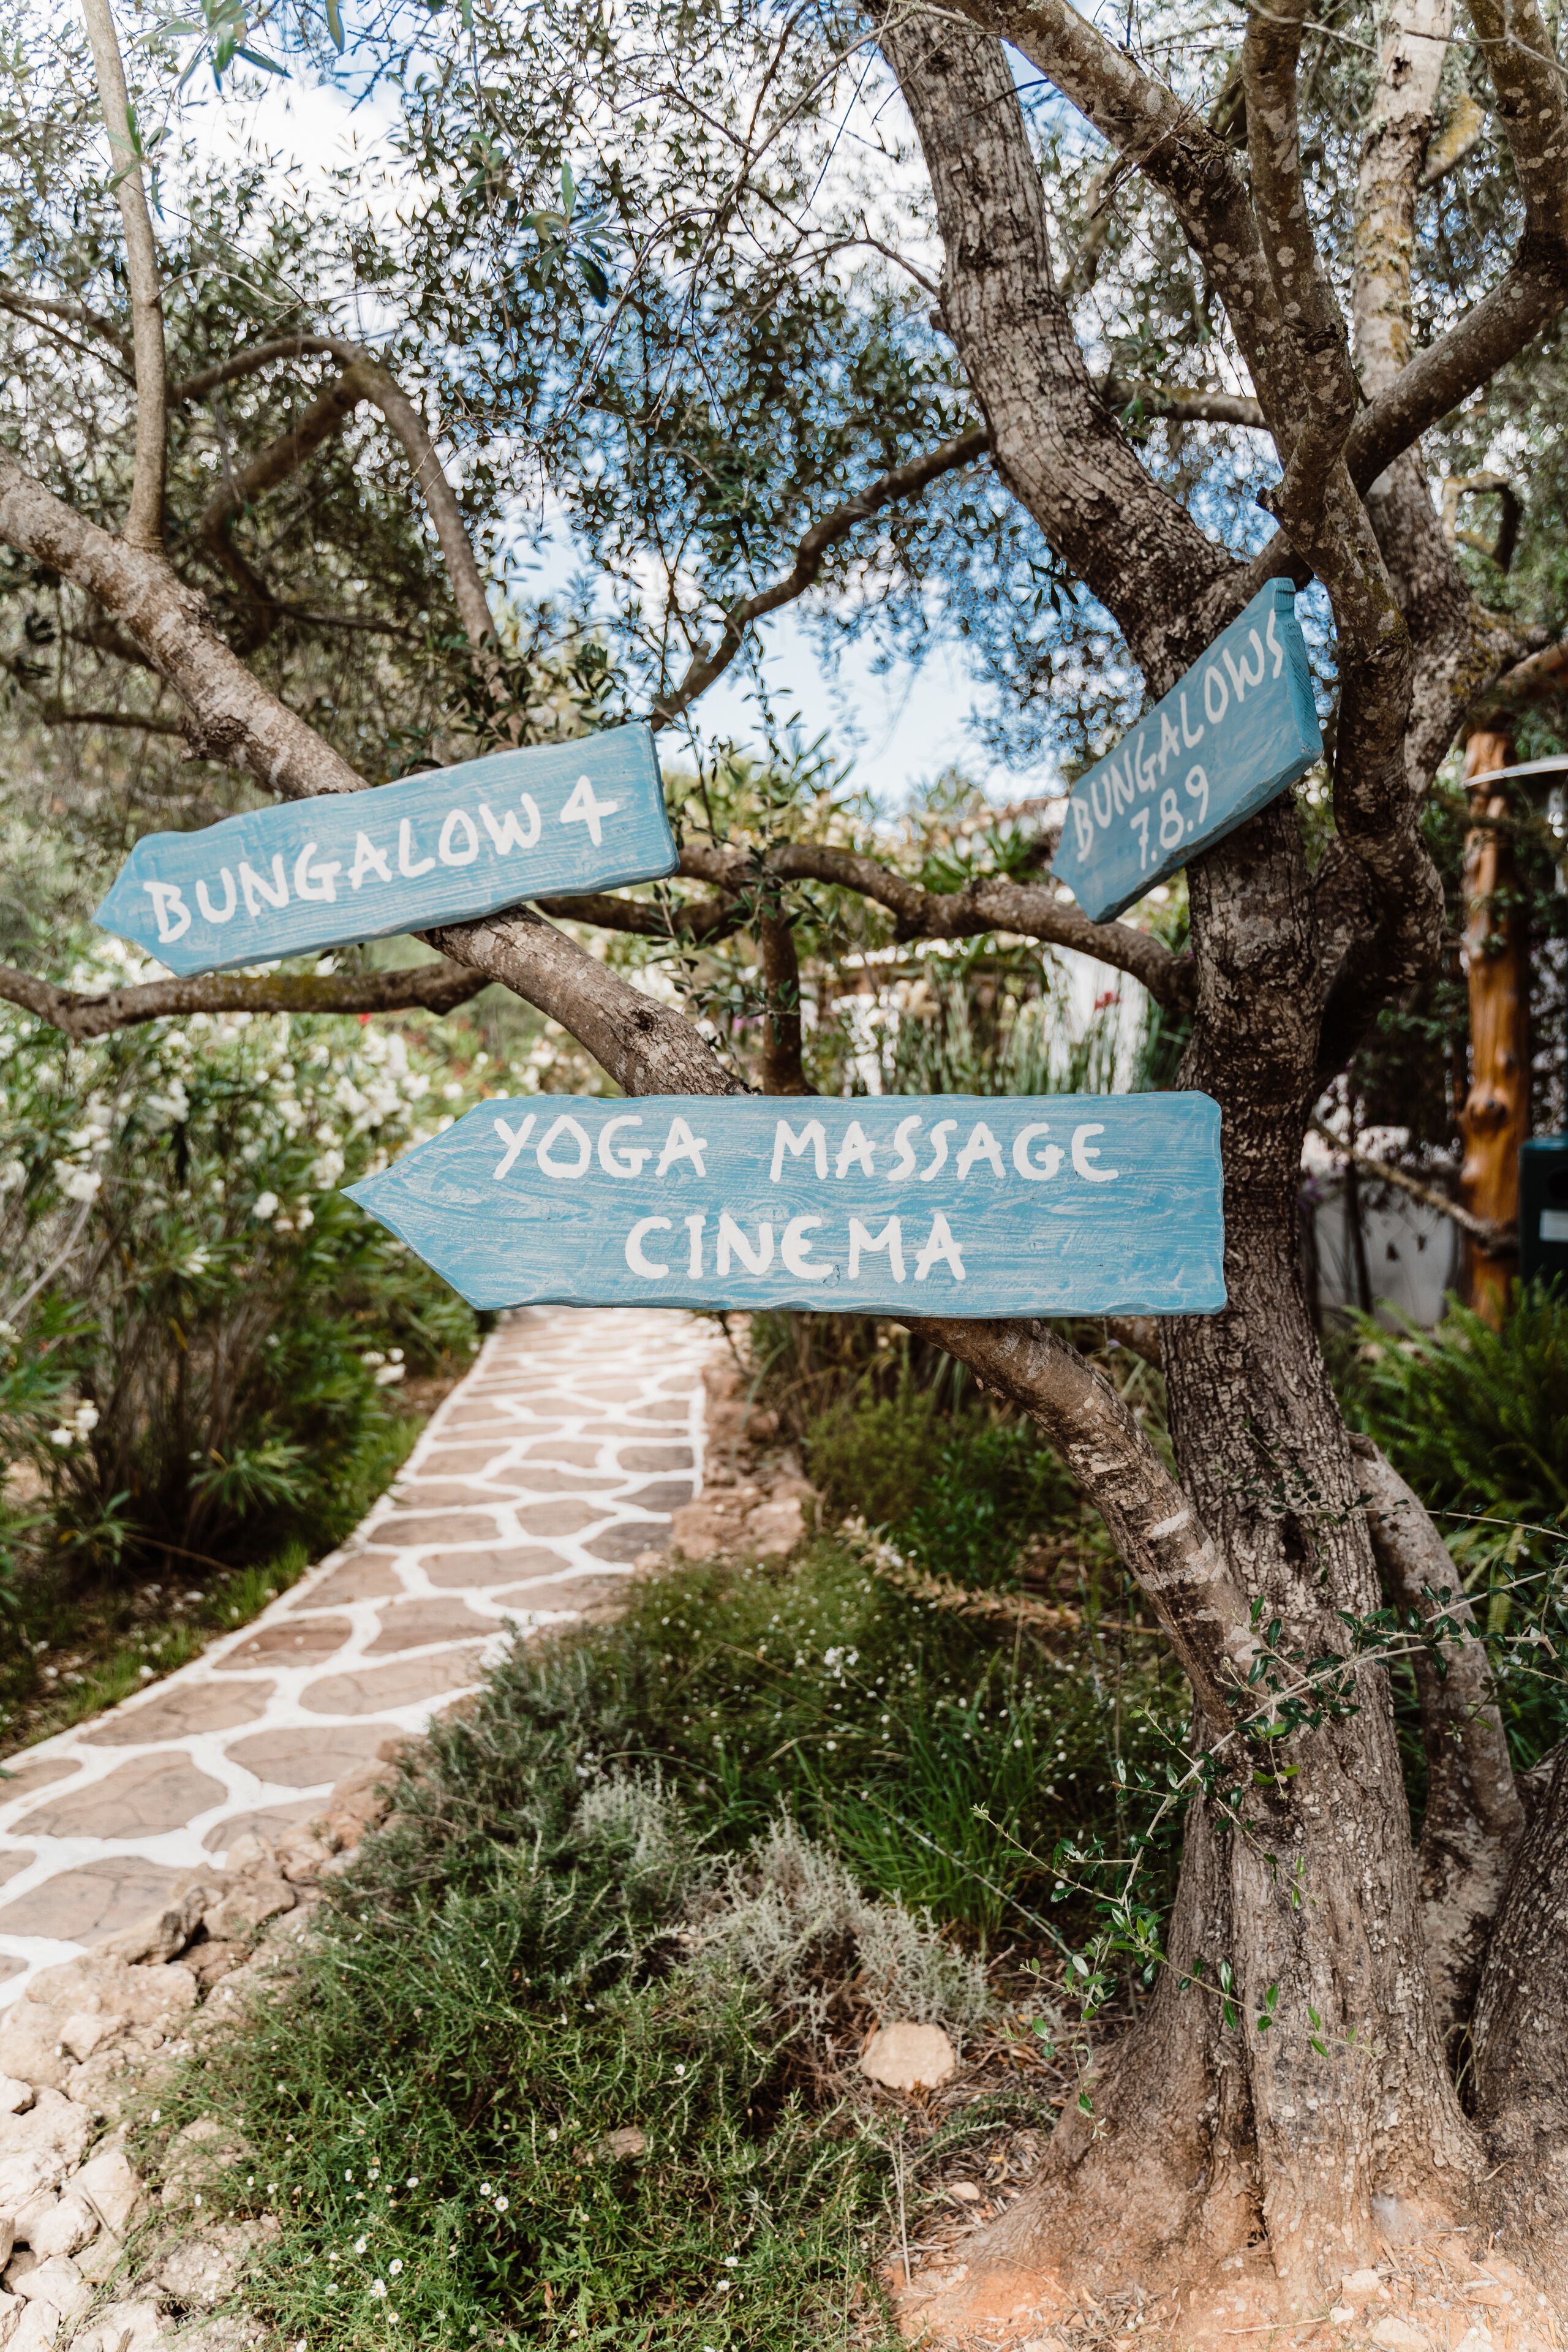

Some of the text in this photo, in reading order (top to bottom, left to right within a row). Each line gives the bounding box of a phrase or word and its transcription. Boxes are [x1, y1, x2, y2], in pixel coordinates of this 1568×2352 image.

[1070, 609, 1283, 862] BUNGALOWS
[144, 775, 617, 943] BUNGALOW 4
[1131, 766, 1208, 870] 7.8.9
[494, 1114, 1119, 1182] YOGA MASSAGE
[625, 1214, 966, 1281] CINEMA
